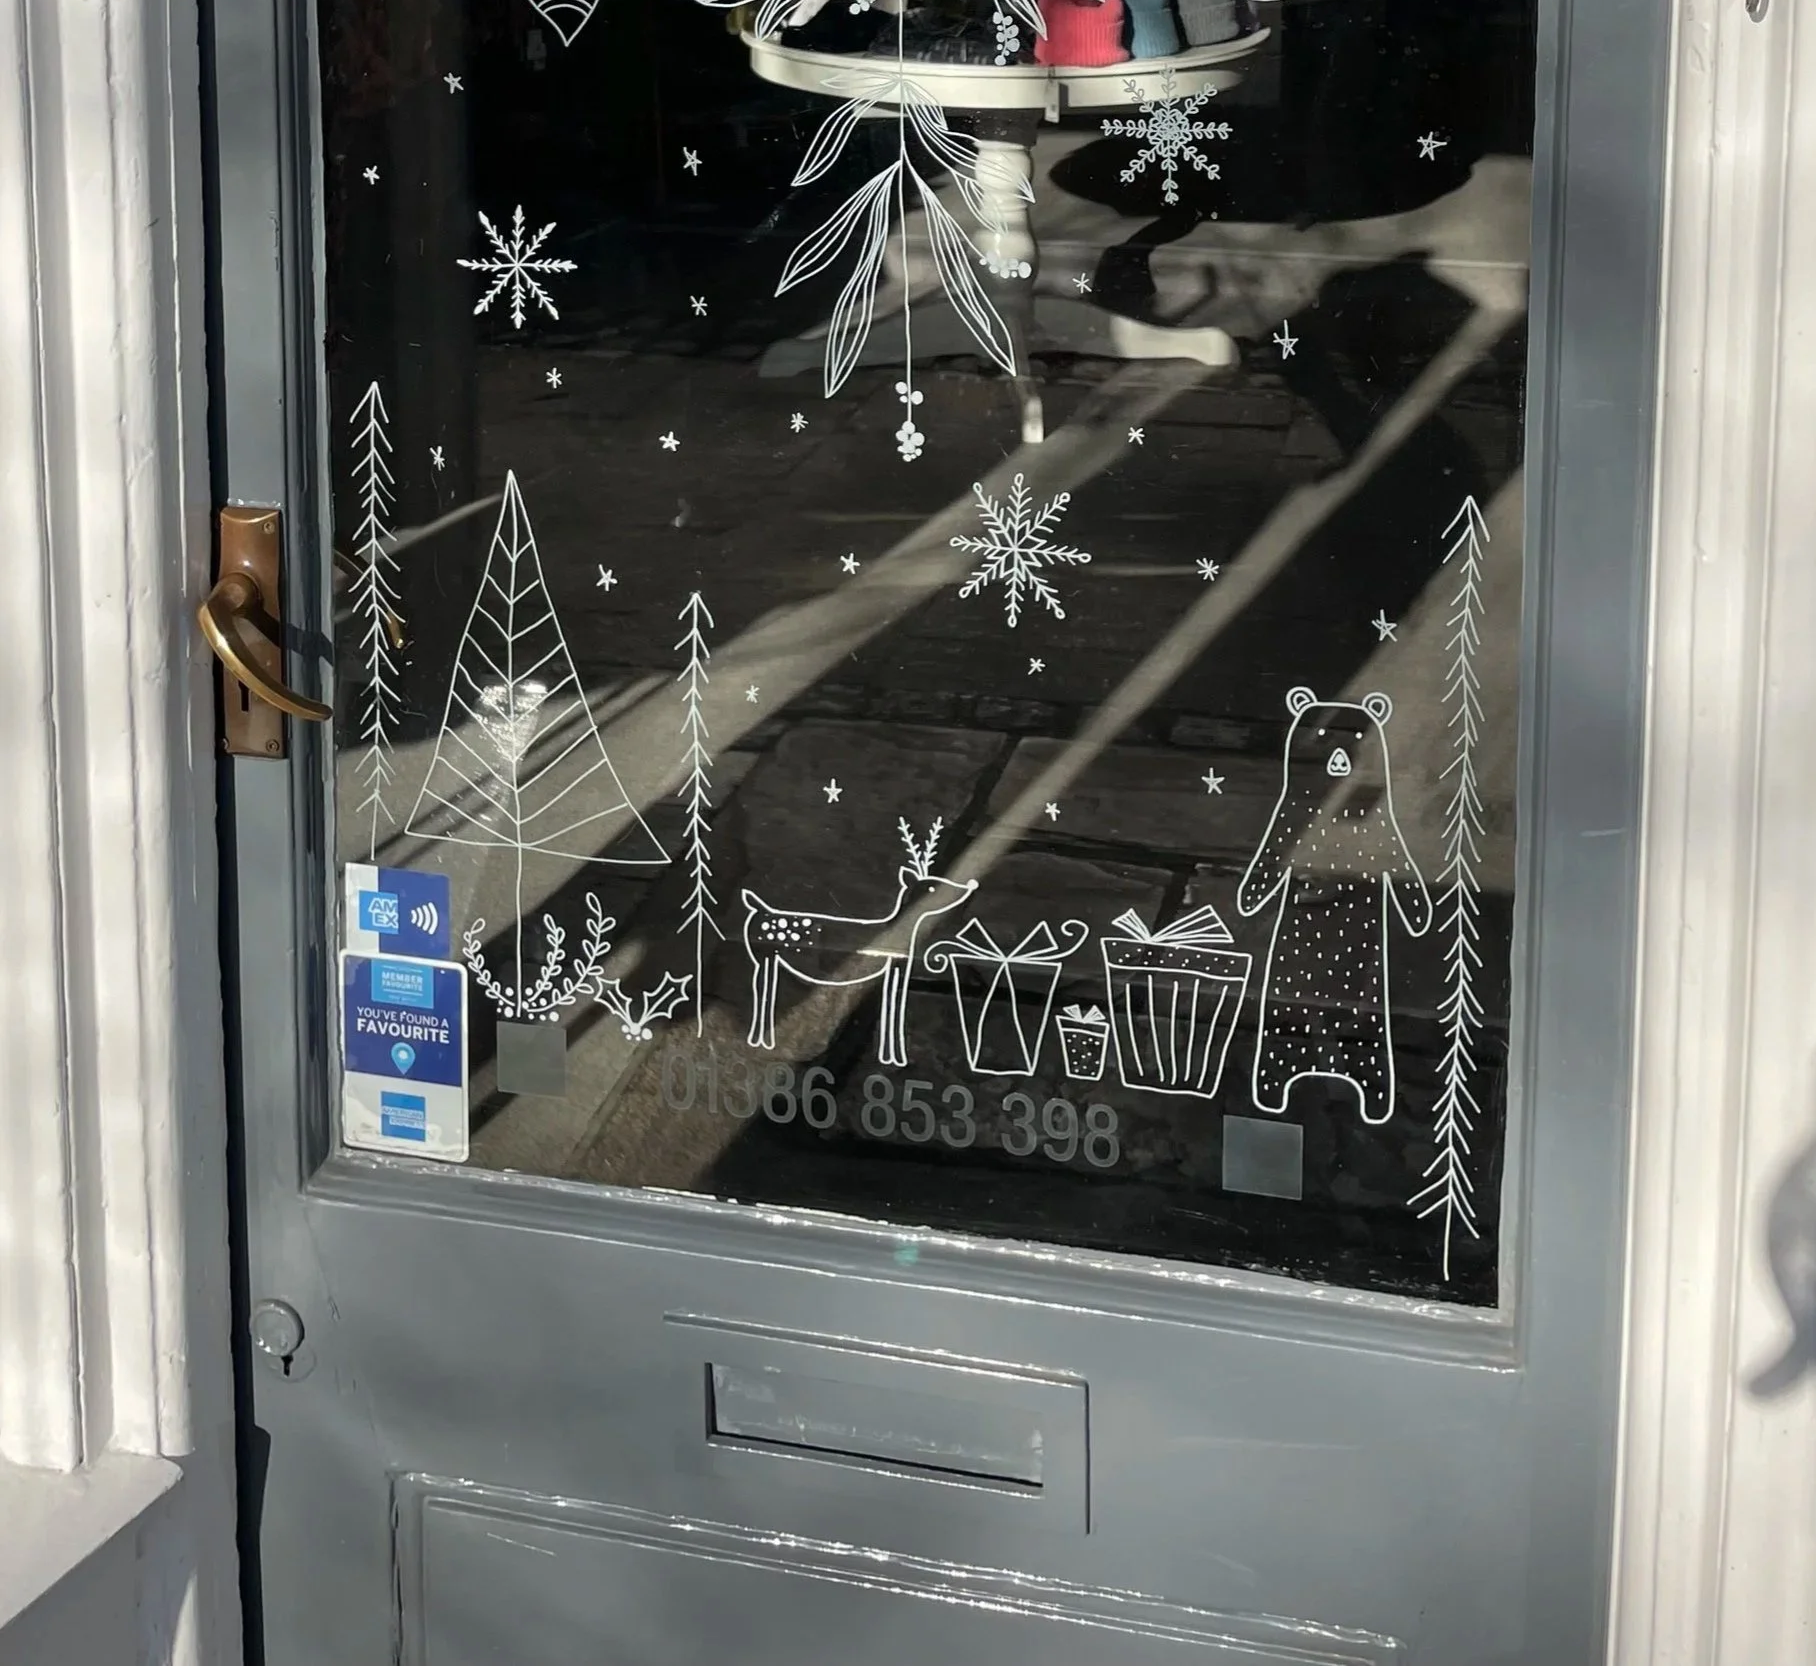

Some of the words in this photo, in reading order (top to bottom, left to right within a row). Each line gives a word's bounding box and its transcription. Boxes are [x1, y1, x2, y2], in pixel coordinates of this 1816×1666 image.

[381, 971, 423, 984] MEMBER
[357, 1006, 397, 1022] YOU'VE
[400, 1012, 439, 1027] FOUND
[441, 1018, 449, 1029] A
[357, 1018, 450, 1044] FAVOURITE
[662, 1052, 837, 1129] 01386
[861, 1074, 976, 1148] 853
[1001, 1092, 1120, 1168] 398
